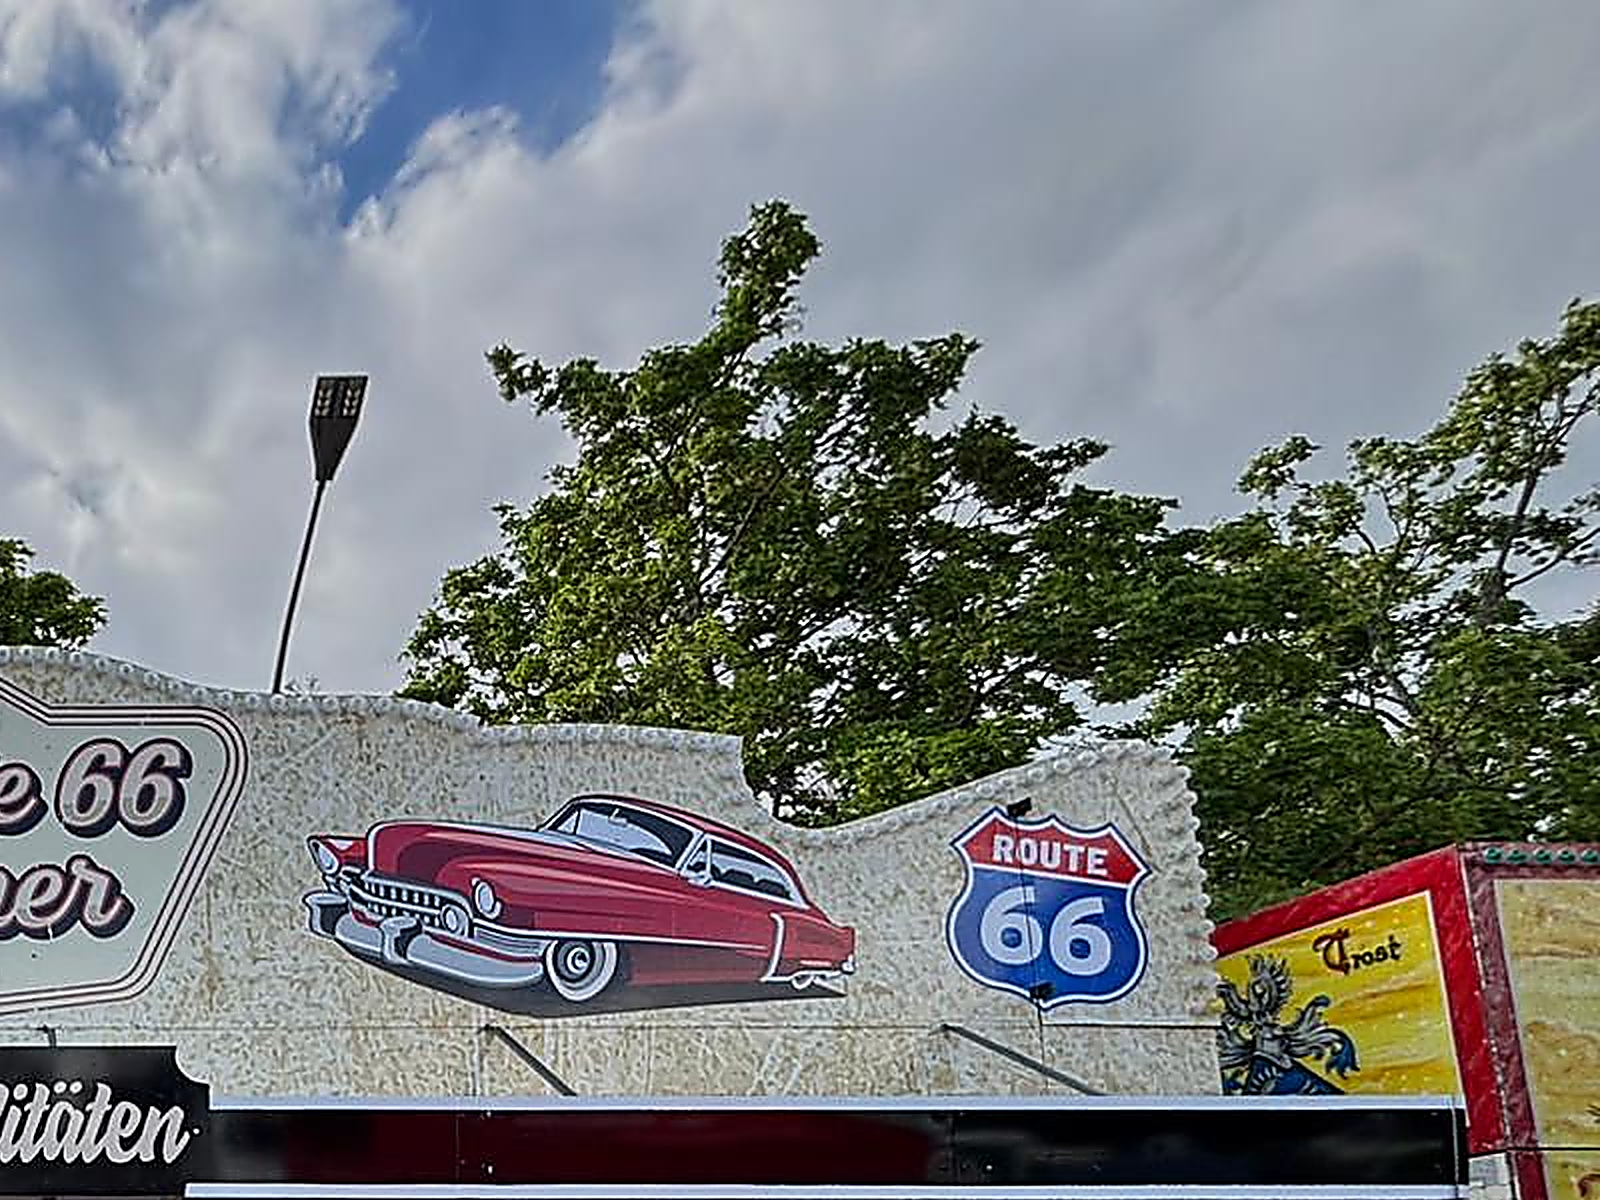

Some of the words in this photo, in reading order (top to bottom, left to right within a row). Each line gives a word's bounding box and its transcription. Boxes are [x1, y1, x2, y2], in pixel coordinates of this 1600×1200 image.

[53, 736, 193, 838] 66
[992, 834, 1108, 875] ROUTE
[980, 885, 1112, 976] 66
[1312, 928, 1402, 975] Trost
